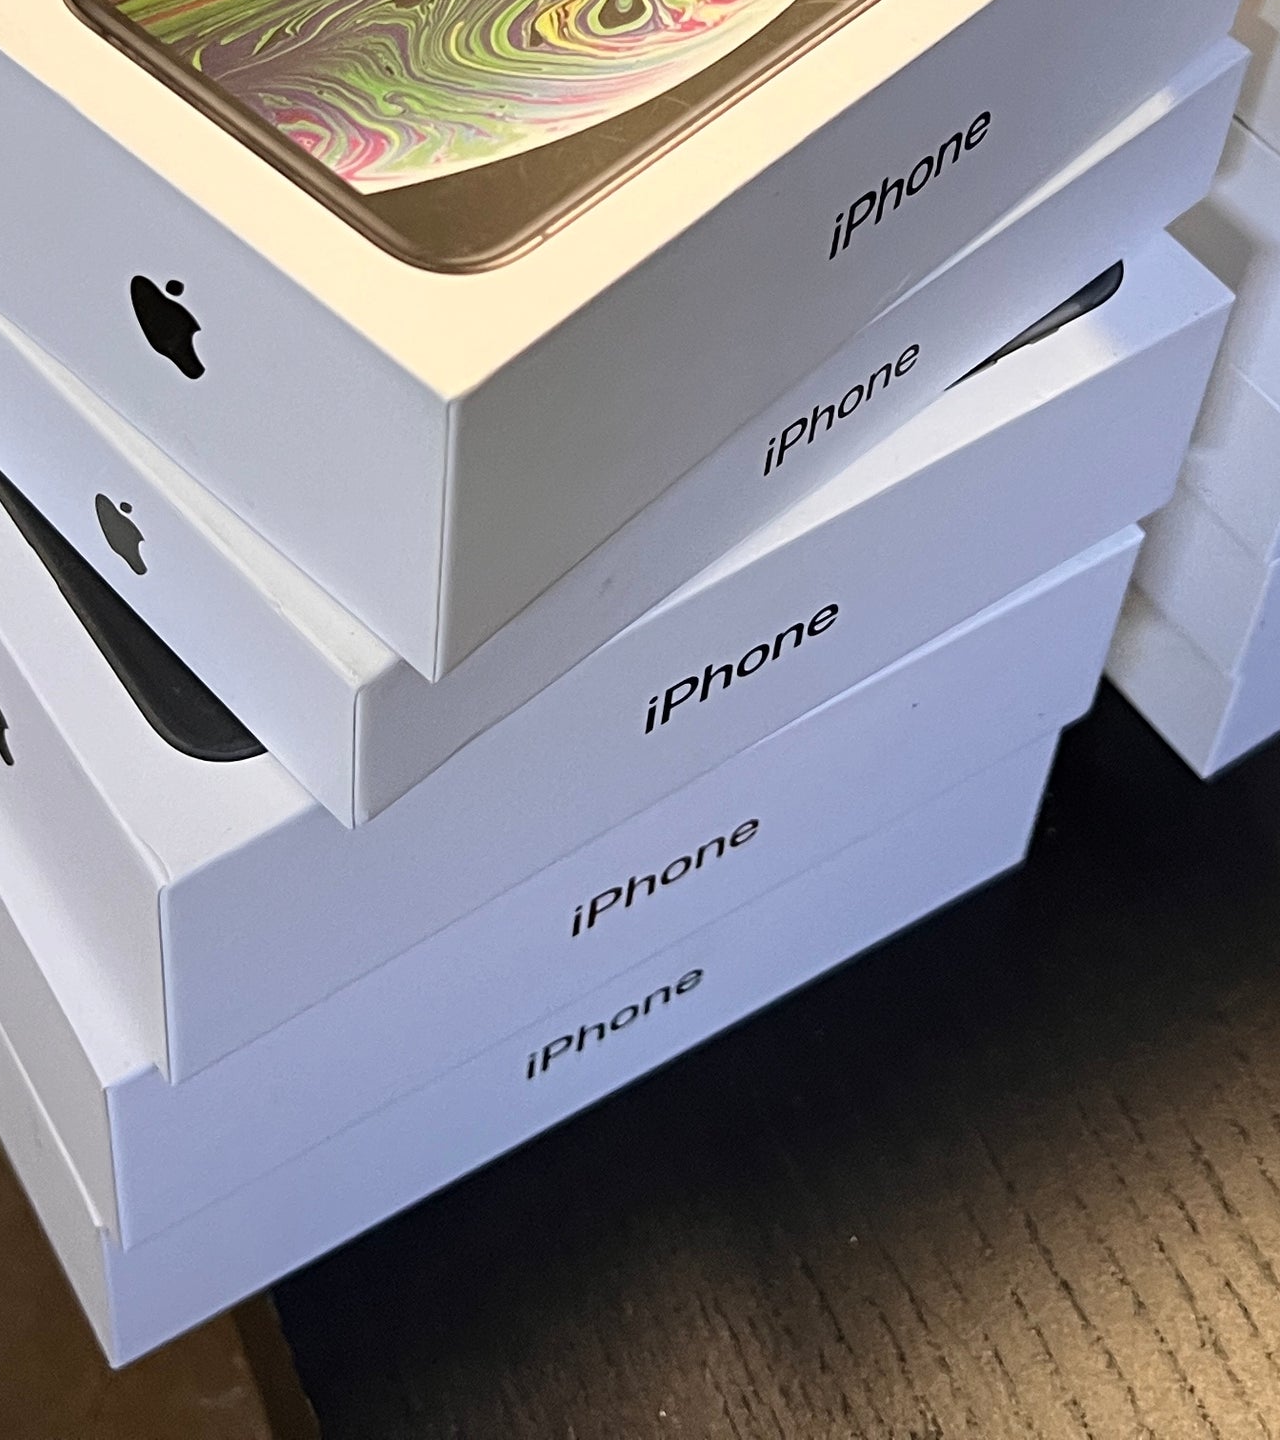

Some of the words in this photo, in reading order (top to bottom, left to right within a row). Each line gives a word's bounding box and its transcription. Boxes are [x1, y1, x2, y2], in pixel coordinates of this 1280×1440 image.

[828, 110, 992, 261] iPhone
[762, 343, 920, 477] iPhone
[644, 603, 839, 735] iPhone
[570, 818, 760, 938] iPhone
[525, 968, 705, 1080] iPhone
